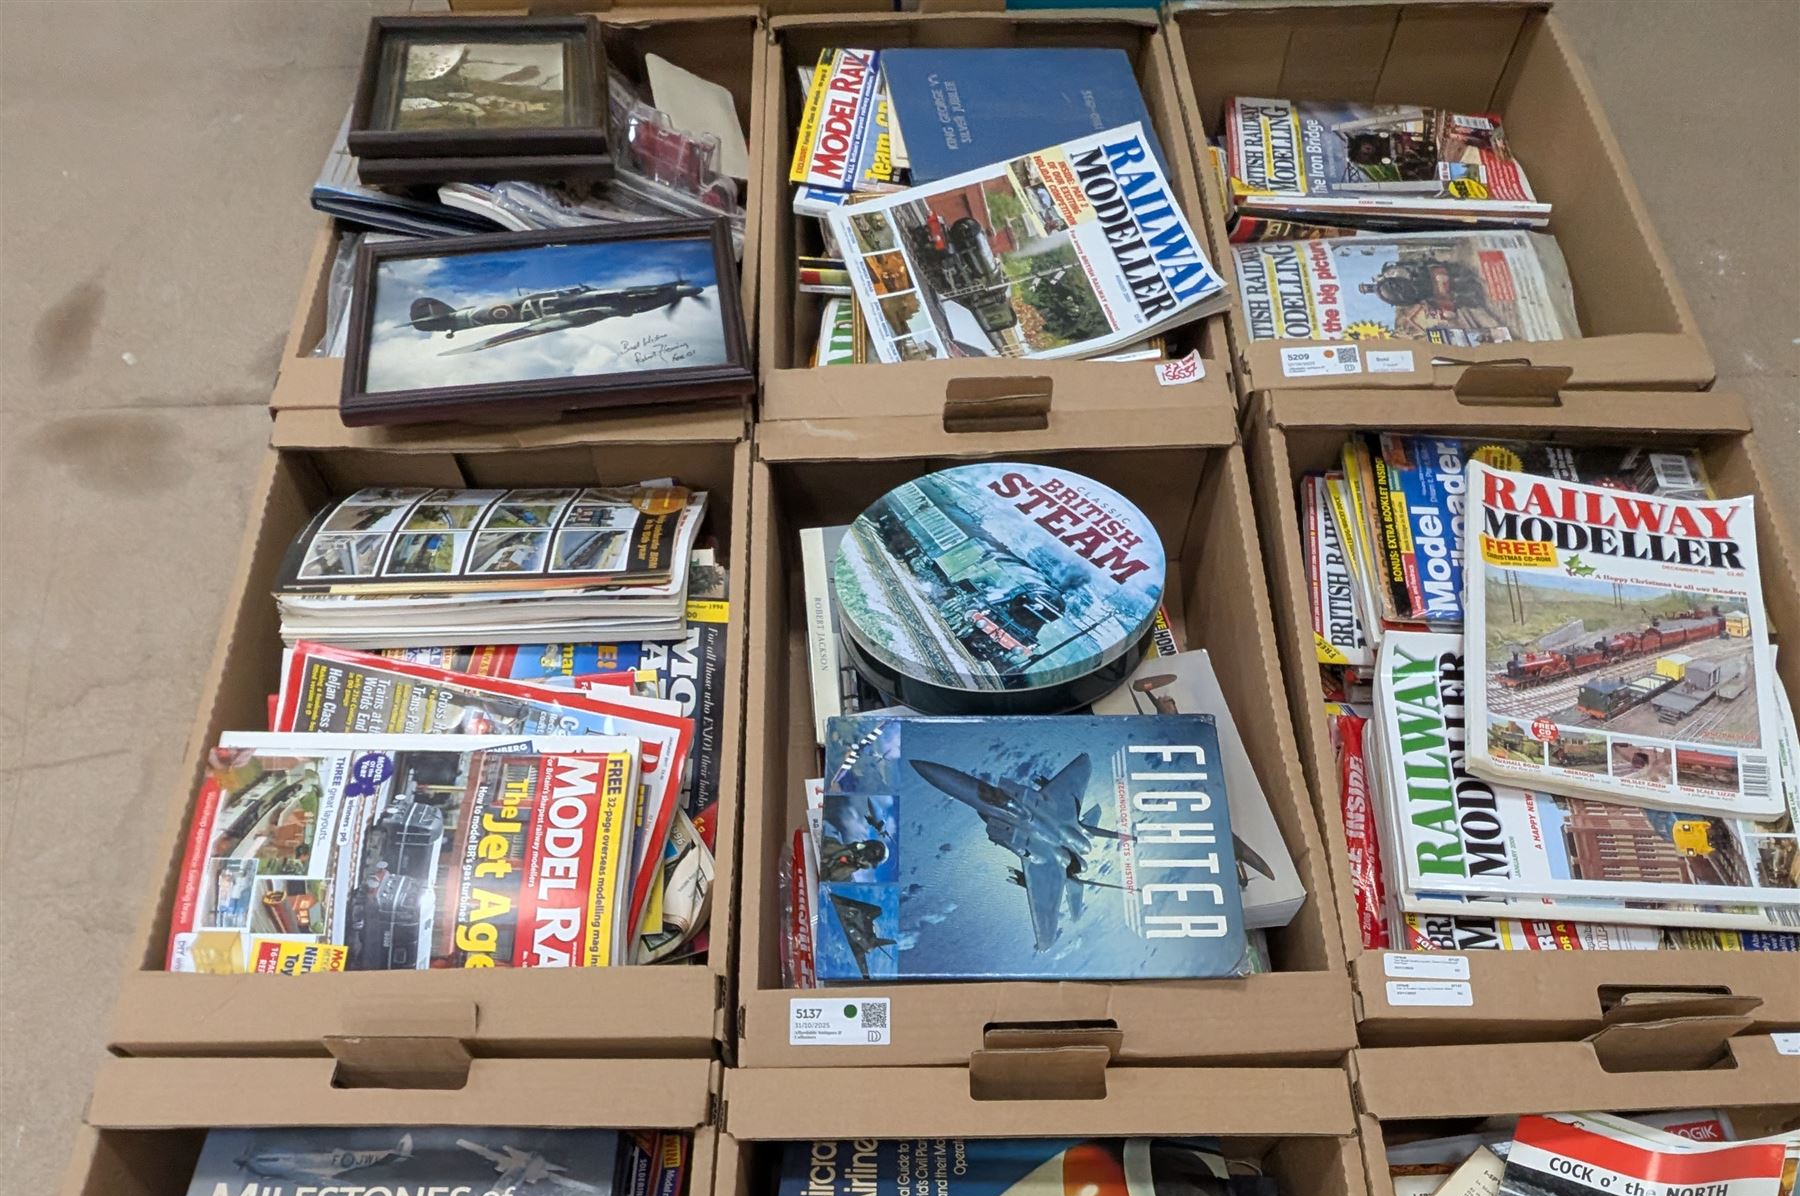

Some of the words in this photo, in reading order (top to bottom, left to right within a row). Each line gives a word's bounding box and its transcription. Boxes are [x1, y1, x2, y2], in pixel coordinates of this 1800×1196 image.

[830, 53, 871, 95] RAIL
[811, 97, 859, 181] MODEL
[1305, 119, 1324, 153] Bridge
[1309, 153, 1325, 177] Iron
[1309, 178, 1328, 194] The
[1070, 146, 1178, 321] MODELLER
[1103, 135, 1221, 303] RAILWAY
[1261, 244, 1312, 338] ODELLING
[1316, 283, 1340, 305] big
[1248, 300, 1274, 340] ITISH
[1322, 308, 1342, 333] the
[1287, 353, 1310, 362] 5209
[1040, 477, 1147, 550] BRITISH
[1076, 485, 1132, 525] CLASSIC
[1379, 488, 1394, 525] BOOKLET
[1482, 470, 1740, 541] RAILWAY
[987, 471, 1151, 585] STEAM
[1482, 504, 1746, 570] MODELLER
[1410, 506, 1460, 612] Model
[1485, 537, 1551, 557] FREE!
[1486, 551, 1522, 562] CHRISTMAS
[1524, 554, 1552, 562] CD-ROM
[1603, 574, 1628, 584] Happy
[1630, 577, 1672, 588] Christmas
[1712, 586, 1747, 596] Readers
[813, 596, 827, 635] ROBERT
[1327, 568, 1355, 649] BRITISH
[816, 636, 829, 672] JACKSON
[325, 667, 344, 700] Heljan
[704, 661, 717, 690] those
[359, 677, 378, 711] Worlds
[373, 679, 391, 710] Trains
[435, 691, 453, 720] Cross
[703, 691, 715, 715] who
[319, 701, 337, 728] Class
[1533, 721, 1557, 732] FREE
[332, 757, 346, 786] THREE
[373, 756, 385, 782] MODEL
[607, 759, 623, 795] FREE
[1391, 647, 1467, 878] RAILWAY
[478, 786, 489, 803] How
[501, 778, 529, 819] The
[696, 780, 710, 810] hobby
[537, 756, 600, 900] MODEL
[600, 797, 617, 834] 32-page
[474, 812, 522, 879] Jet
[598, 834, 611, 877] overseas
[1128, 745, 1228, 939] FIGHTER
[458, 882, 471, 922] turbines
[592, 877, 606, 928] modelling
[796, 1008, 822, 1019] 5137
[897, 1152, 910, 1186] Guide
[915, 1156, 928, 1178] Civil
[934, 1155, 948, 1178] their
[1549, 1156, 1593, 1183] COCK
